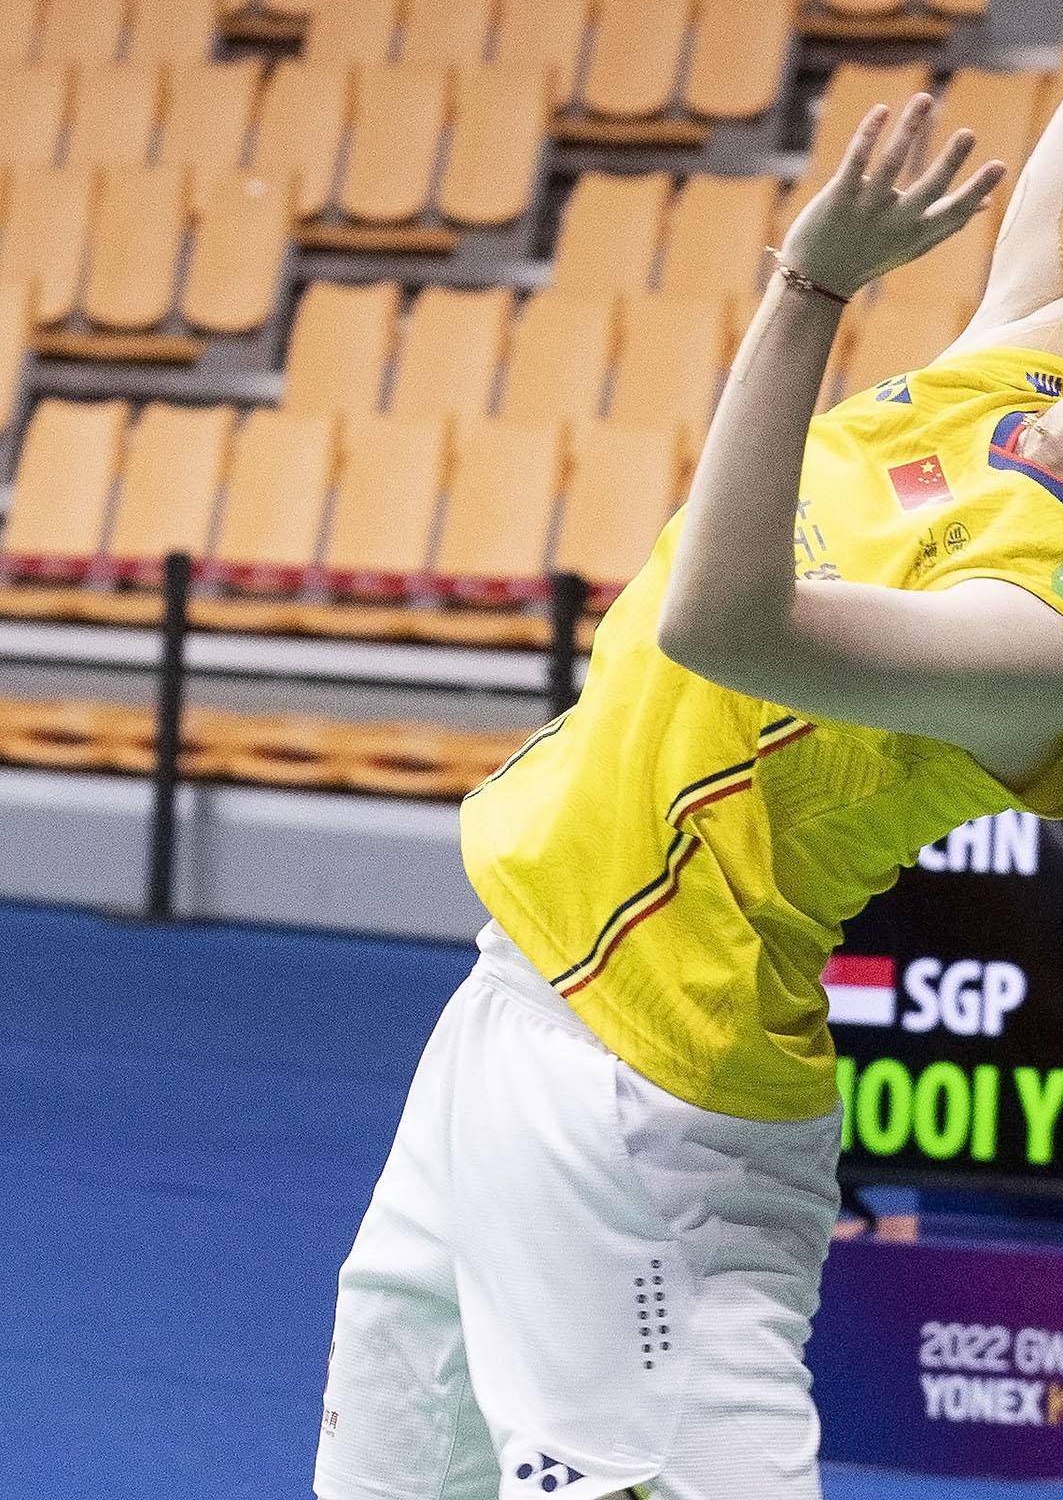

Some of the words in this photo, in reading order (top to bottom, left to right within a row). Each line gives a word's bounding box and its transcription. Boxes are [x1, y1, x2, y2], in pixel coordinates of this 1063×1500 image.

[902, 957, 1028, 1037] SGP
[919, 1321, 1011, 1372] 2022
[920, 1374, 1044, 1427] YONEX
